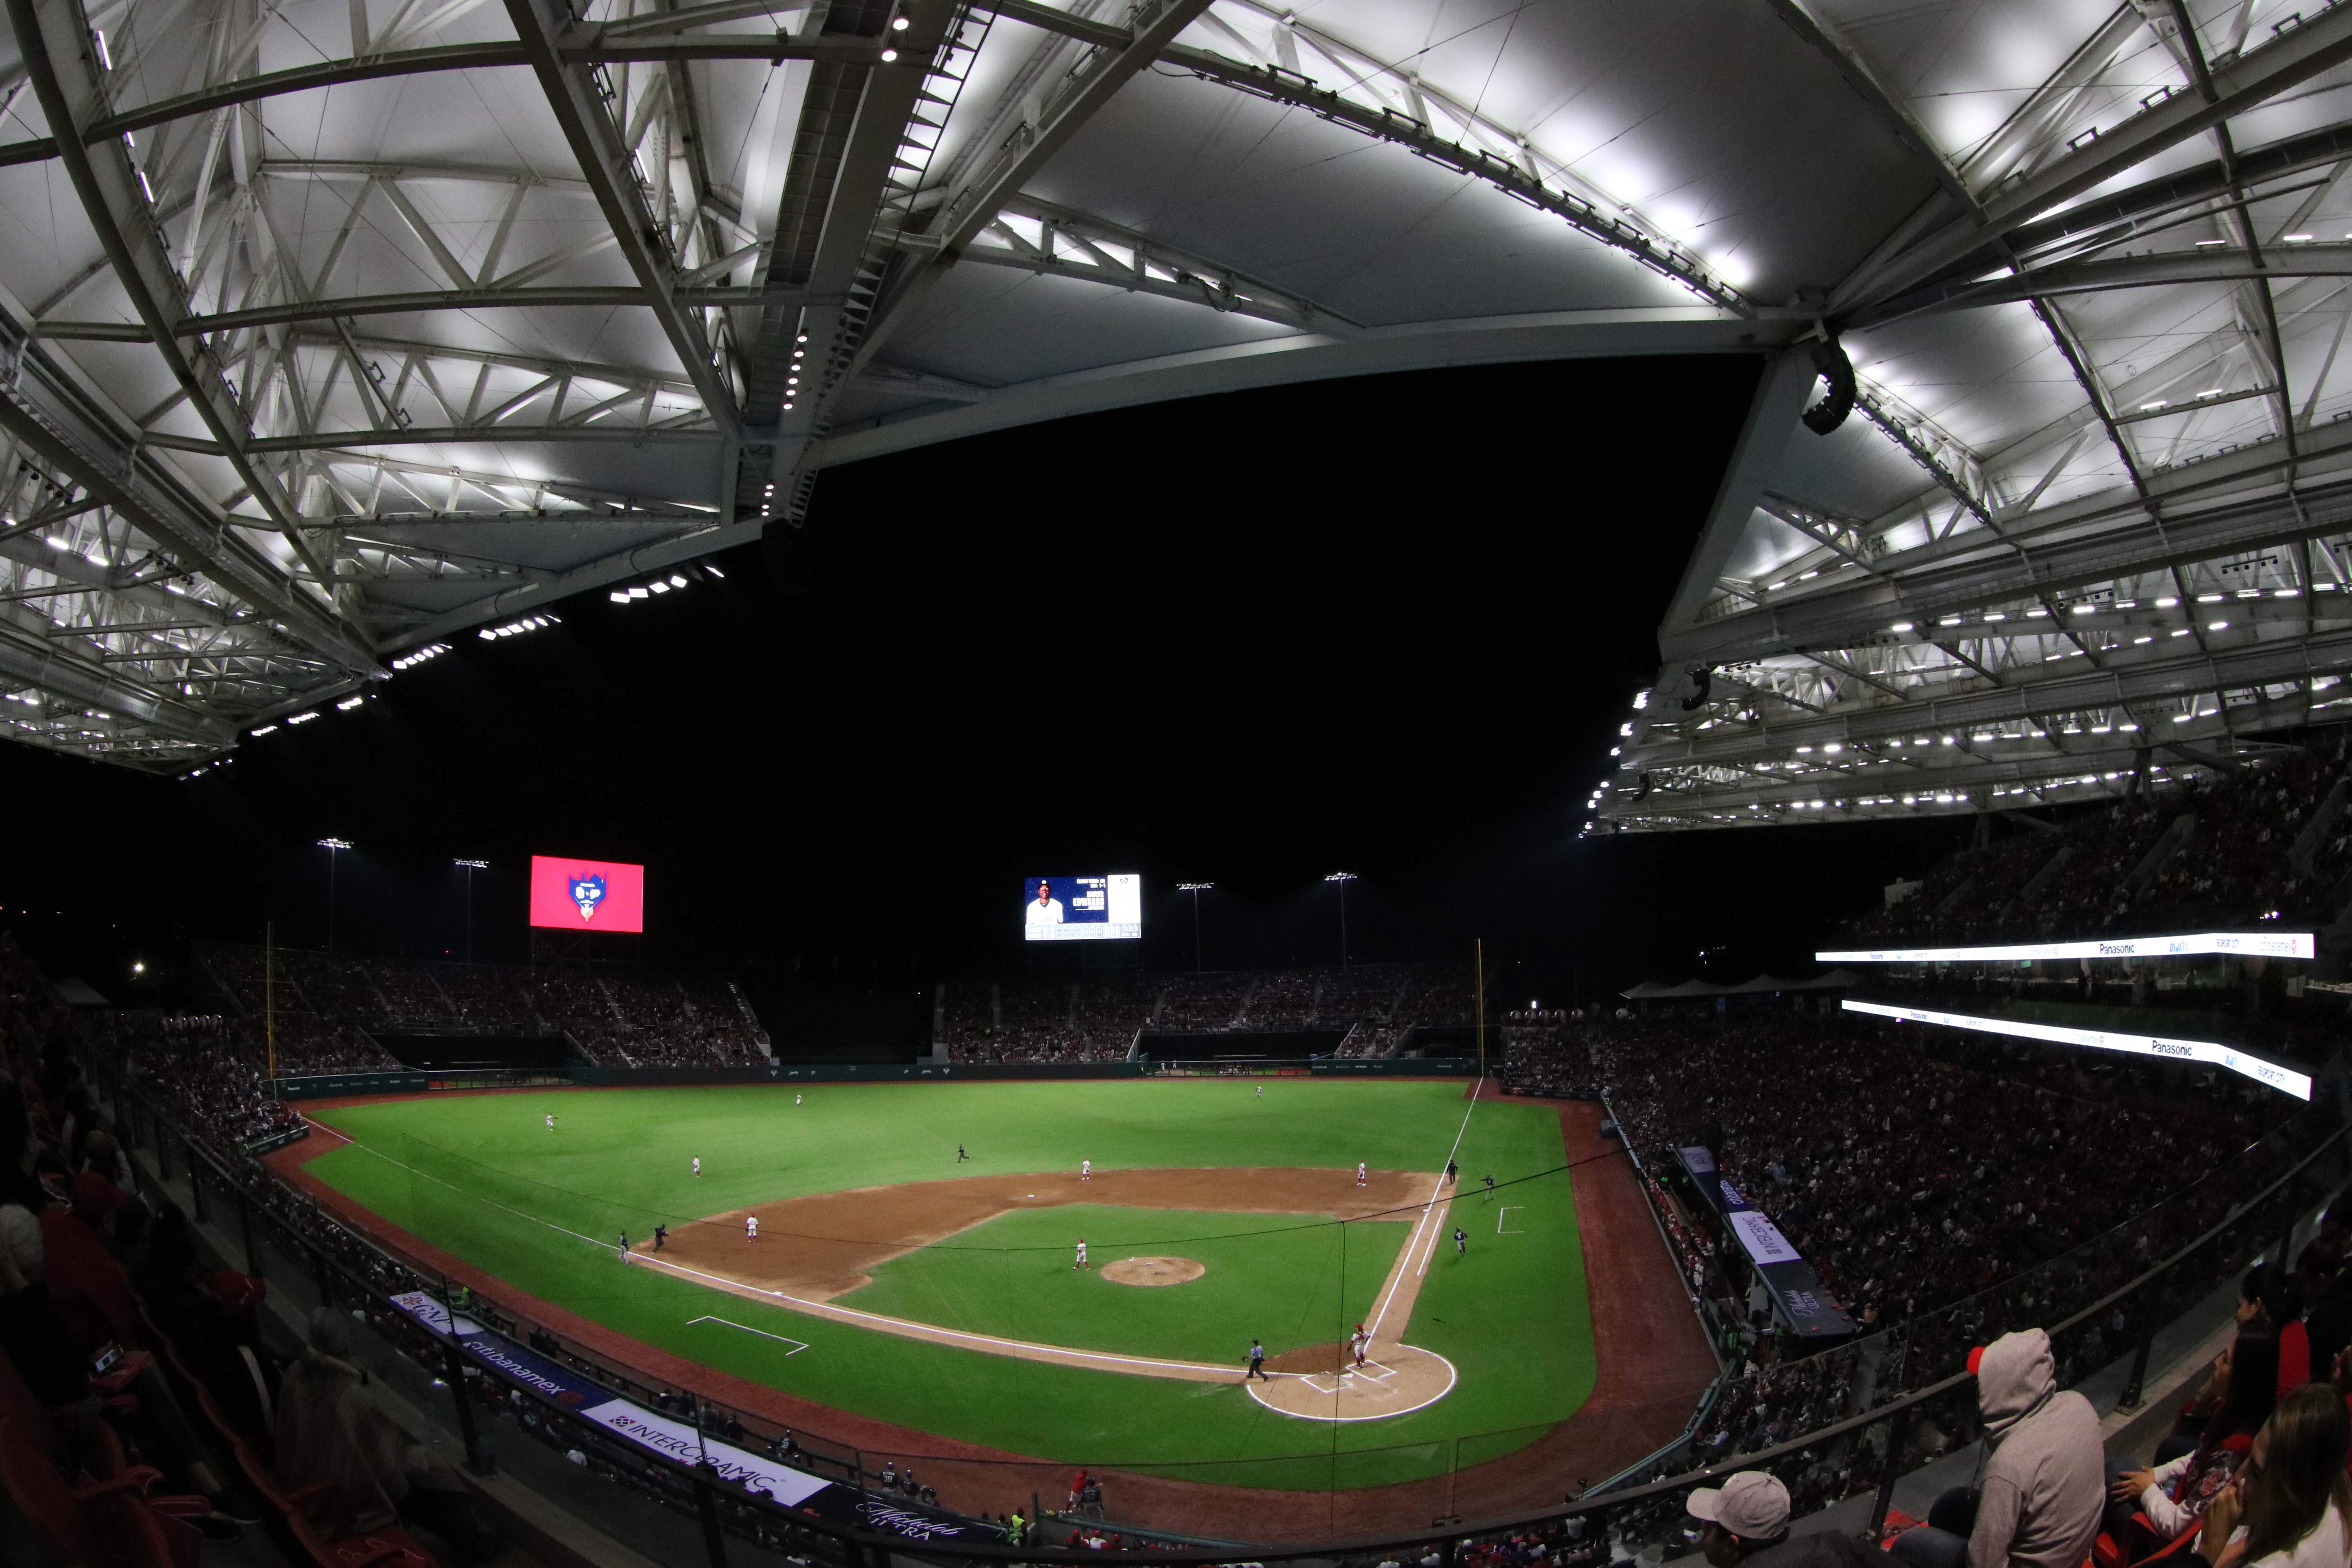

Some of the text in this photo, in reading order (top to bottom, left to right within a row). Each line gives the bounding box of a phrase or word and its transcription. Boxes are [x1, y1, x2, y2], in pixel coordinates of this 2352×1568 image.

[1073, 897, 1104, 906] EDWARDS
[2100, 942, 2135, 955] Panasonic
[2152, 1040, 2192, 1056] Panasonic
[2263, 1067, 2286, 1085] SPORT CITY
[471, 1341, 566, 1395] citibanamex
[856, 1502, 966, 1536] Michelob
[868, 1516, 930, 1541] TRA
